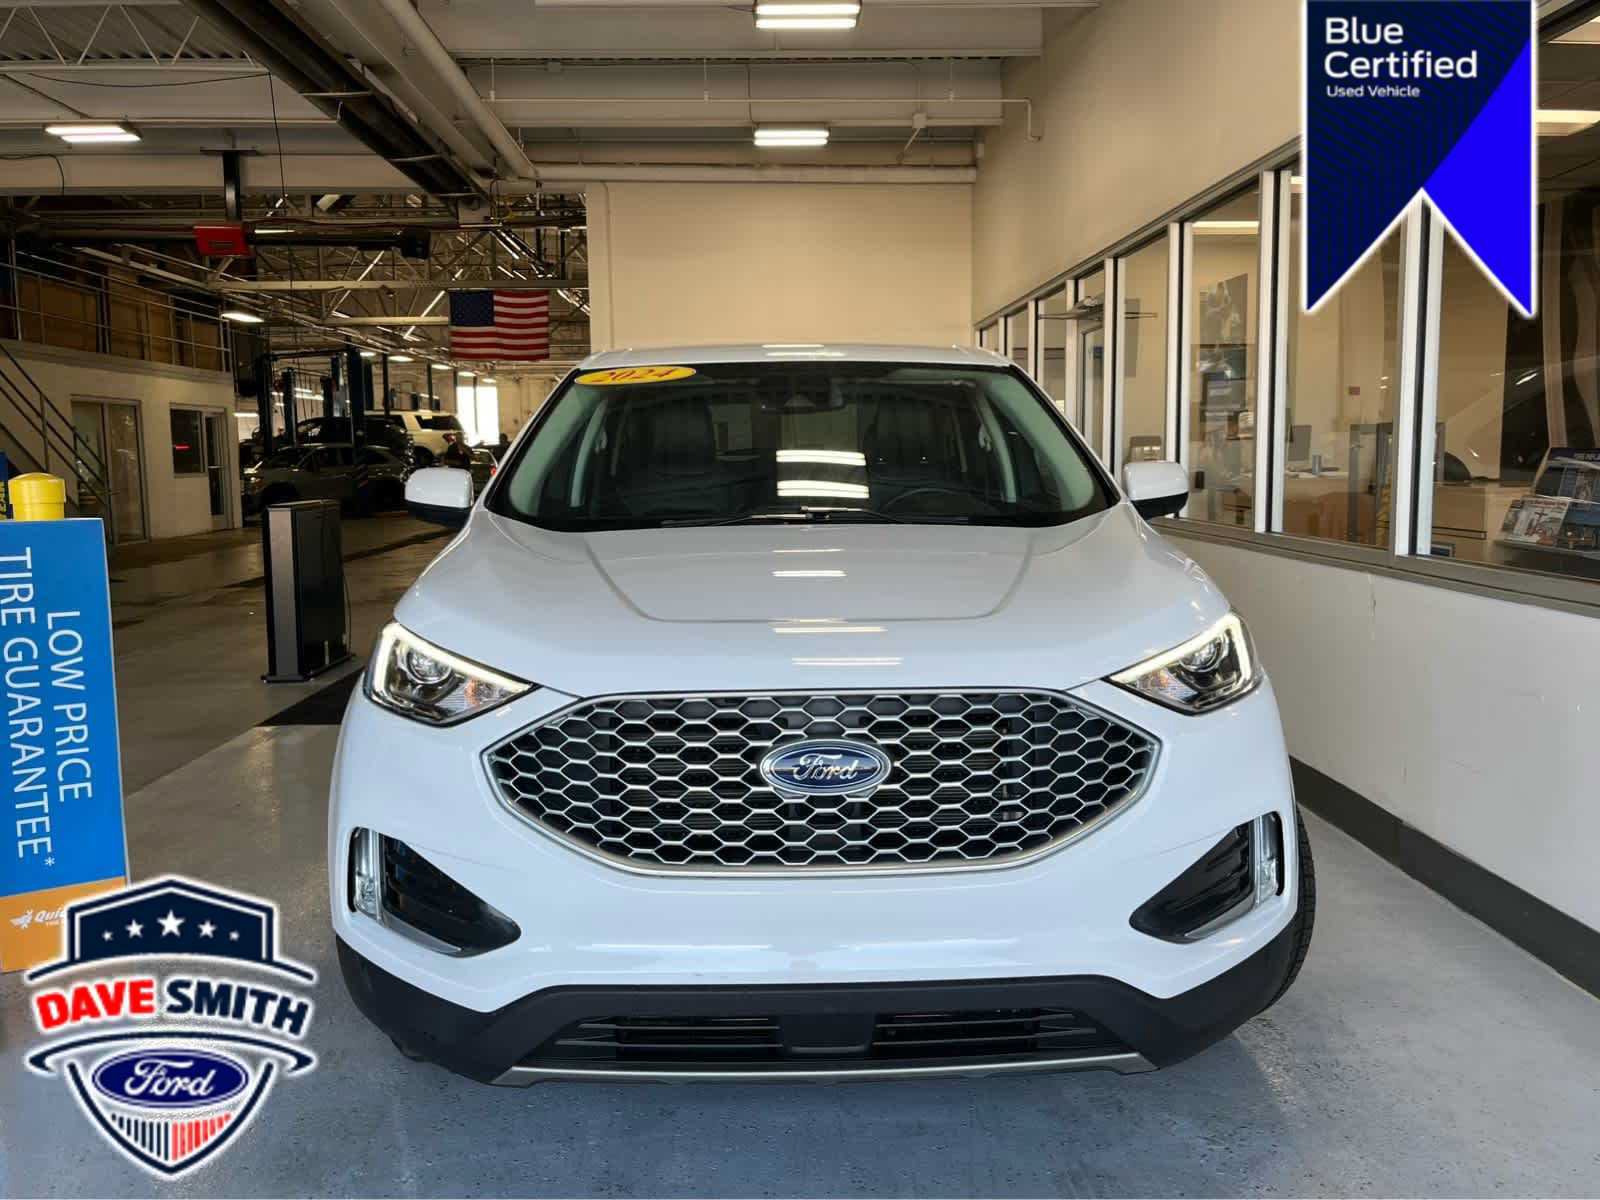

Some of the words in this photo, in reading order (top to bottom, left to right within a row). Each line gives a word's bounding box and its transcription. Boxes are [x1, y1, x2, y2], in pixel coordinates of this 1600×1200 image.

[591, 367, 681, 383] 2024
[0, 546, 36, 626] TIRE
[47, 611, 86, 690] LOW
[53, 703, 92, 802] PRICE
[793, 753, 860, 781] Ford
